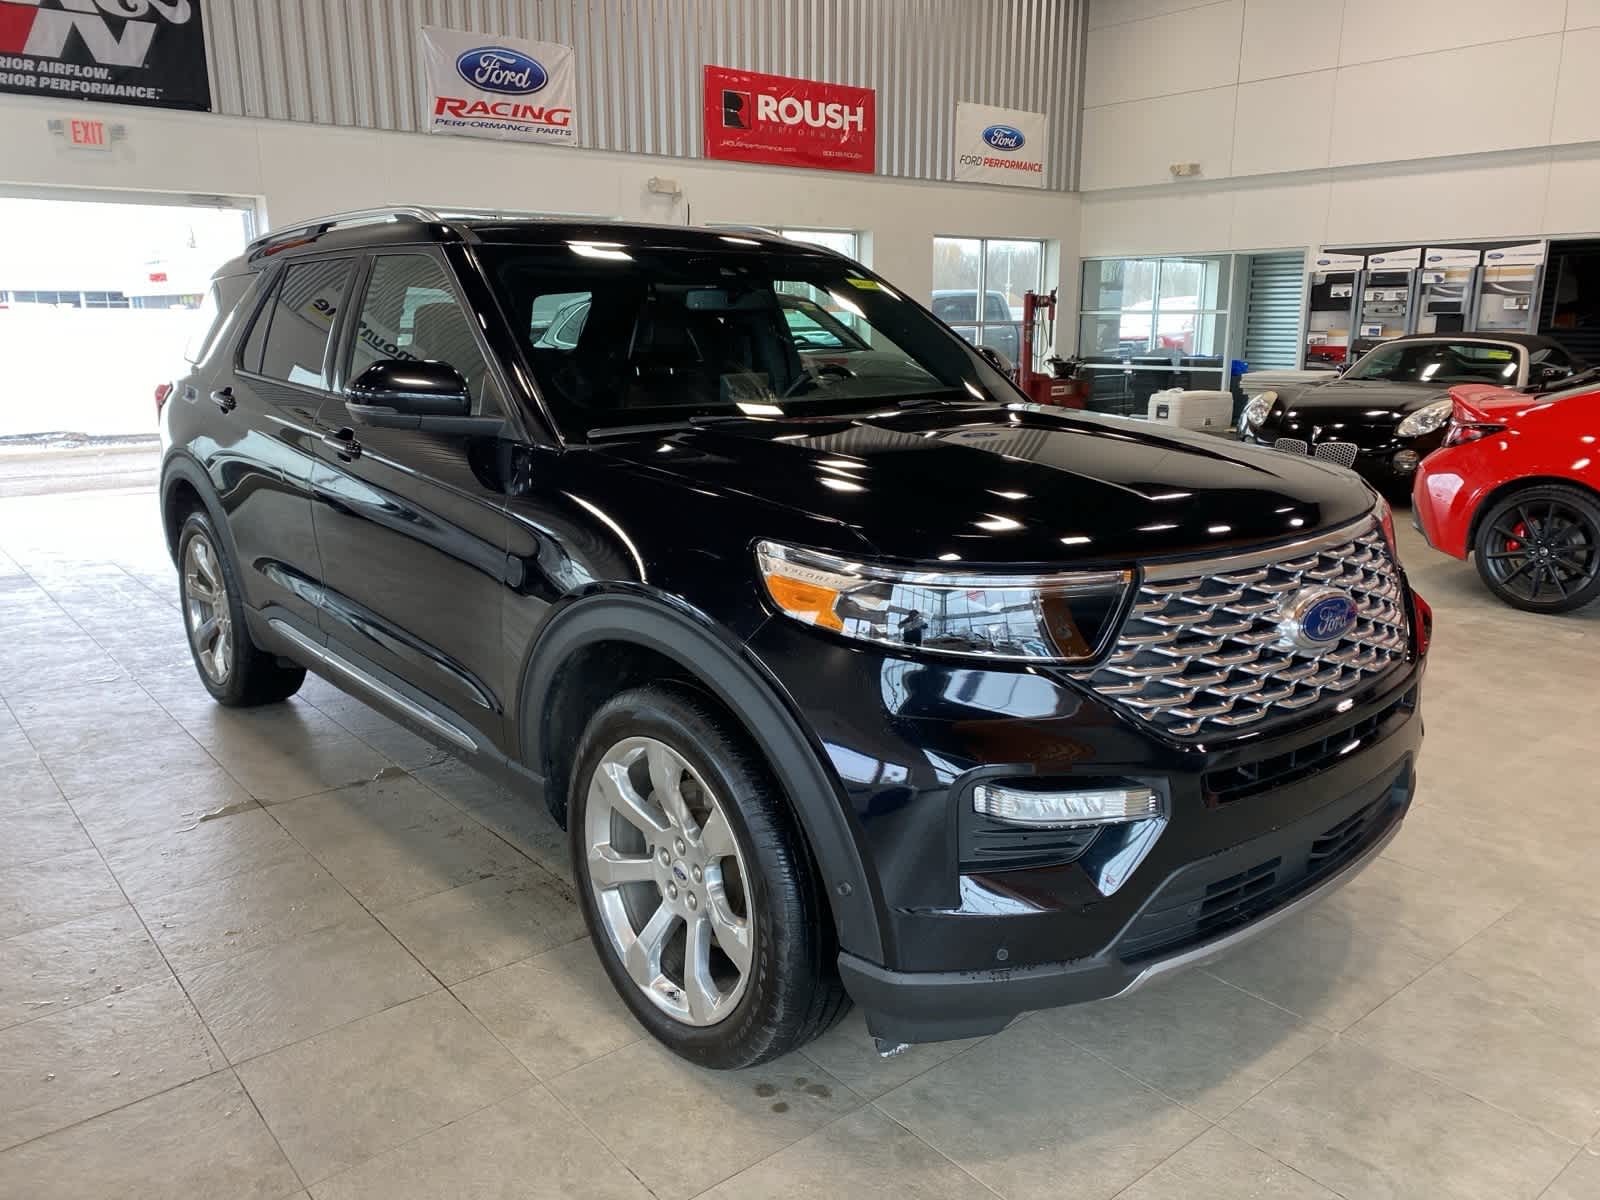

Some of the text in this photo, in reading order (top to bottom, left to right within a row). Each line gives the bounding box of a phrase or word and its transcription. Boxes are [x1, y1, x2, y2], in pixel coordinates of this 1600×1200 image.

[37, 61, 112, 80] AIRFLOW.
[475, 53, 531, 89] Ford
[435, 96, 572, 126] RACING
[757, 94, 864, 132] ROUSH
[70, 120, 104, 145] EXIT
[435, 118, 573, 137] PERFORMANCE PARTS
[990, 128, 1018, 147] Ford
[960, 154, 1043, 173] FORD PERFORMANCE
[1318, 603, 1348, 635] Ford
